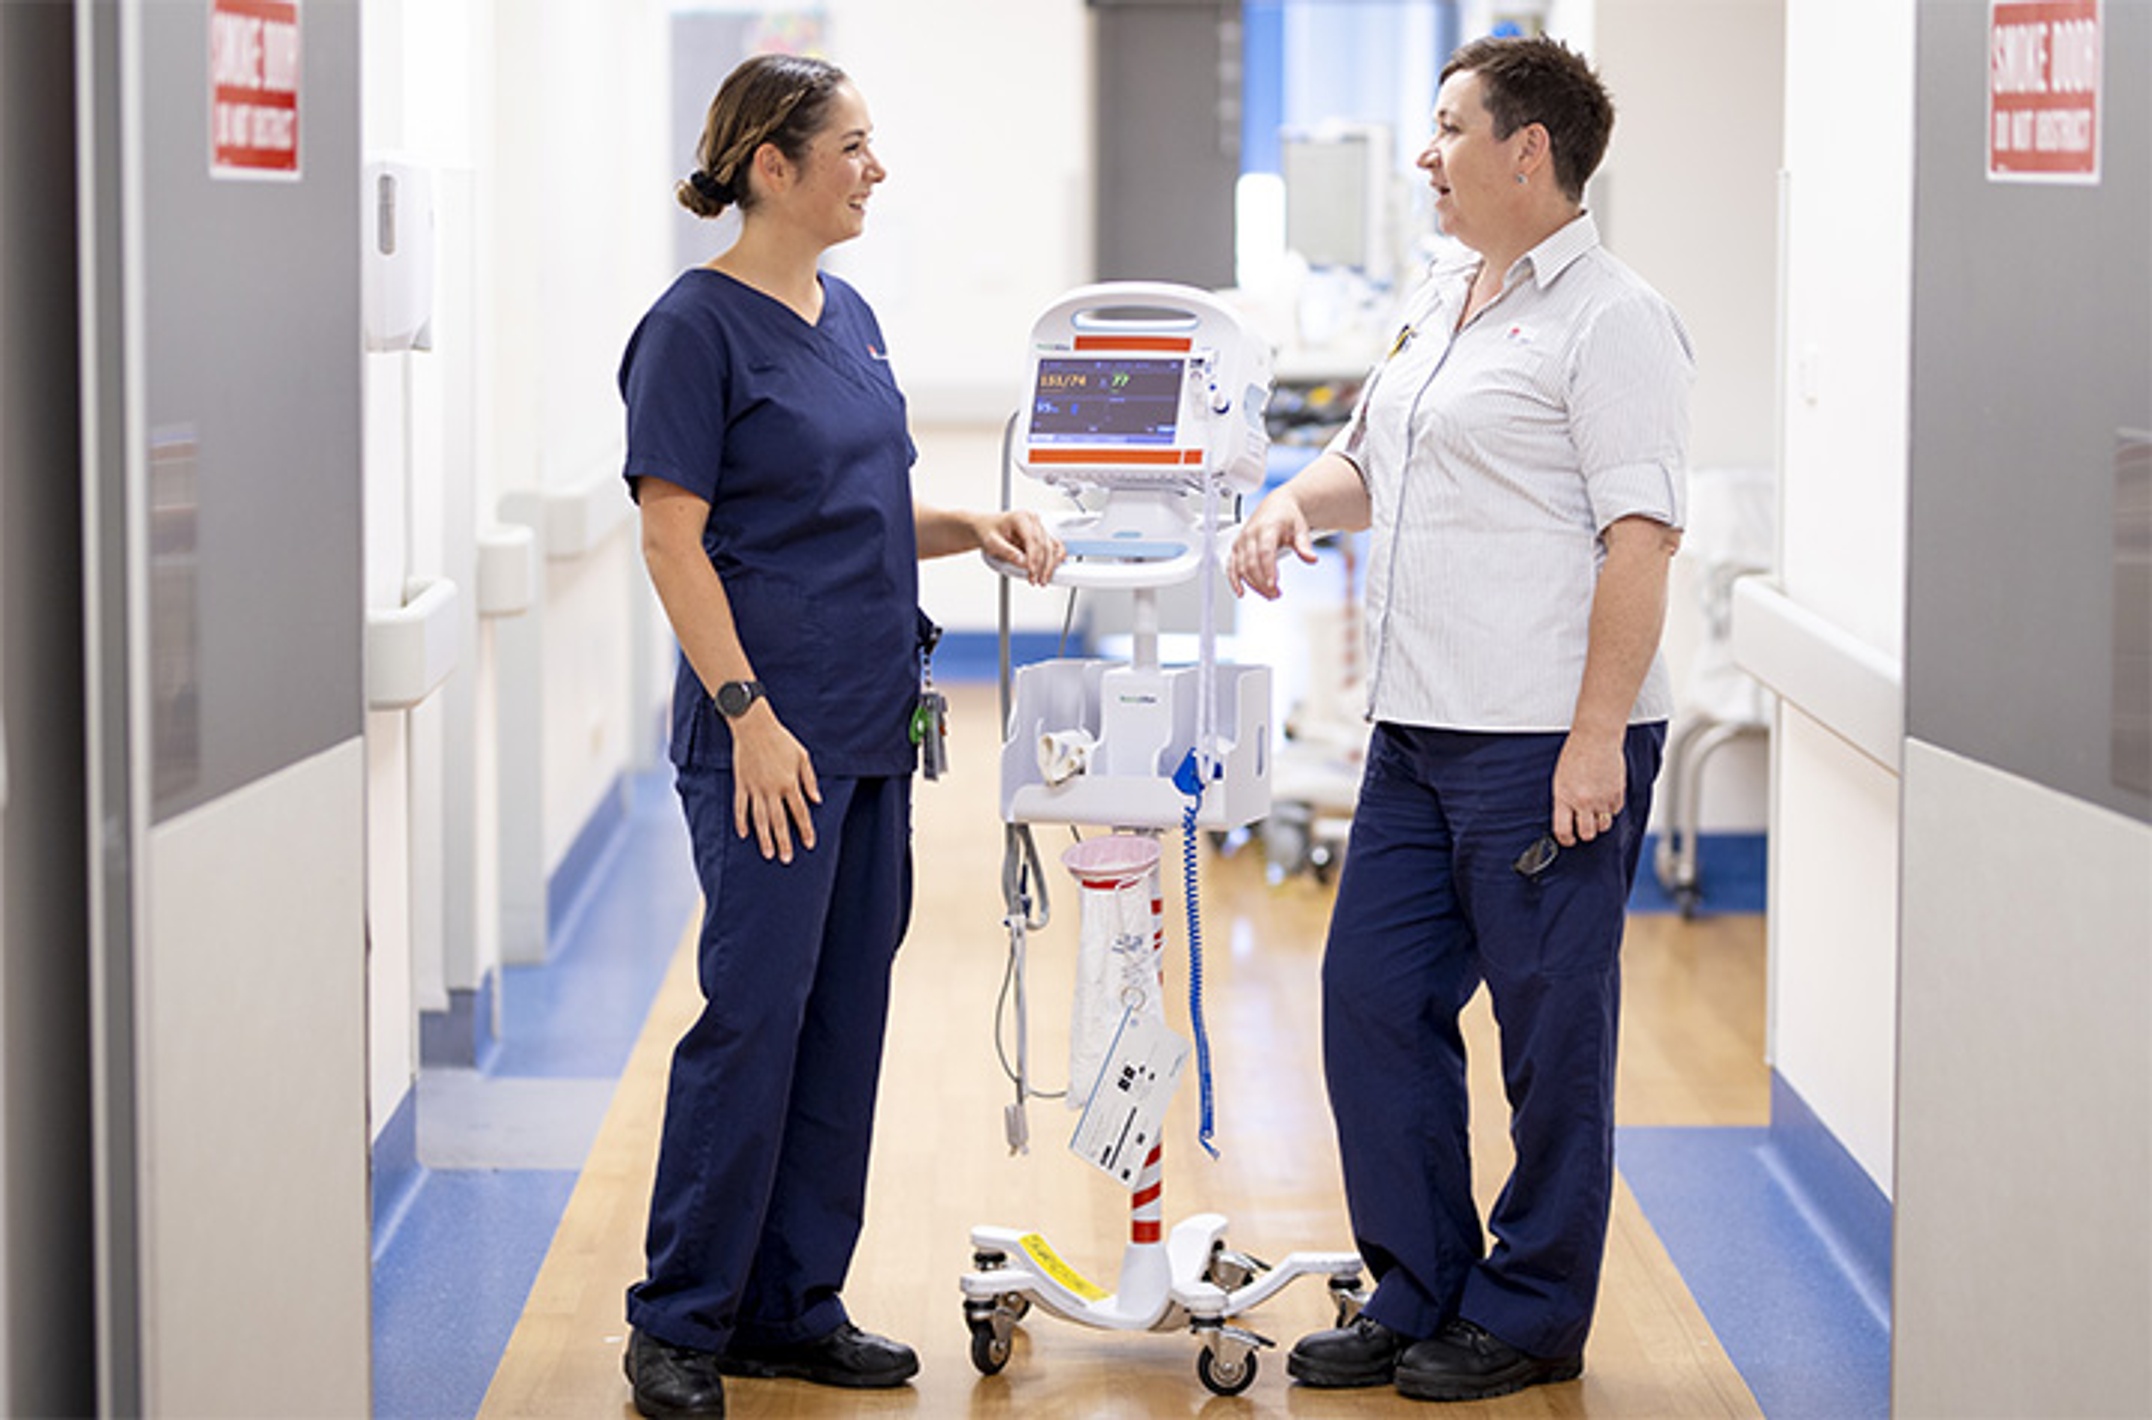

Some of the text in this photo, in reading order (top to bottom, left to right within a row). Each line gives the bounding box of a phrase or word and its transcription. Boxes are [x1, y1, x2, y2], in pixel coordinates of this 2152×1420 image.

[1992, 18, 2097, 93] SMOKE DOOR
[2012, 109, 2034, 150] NOT
